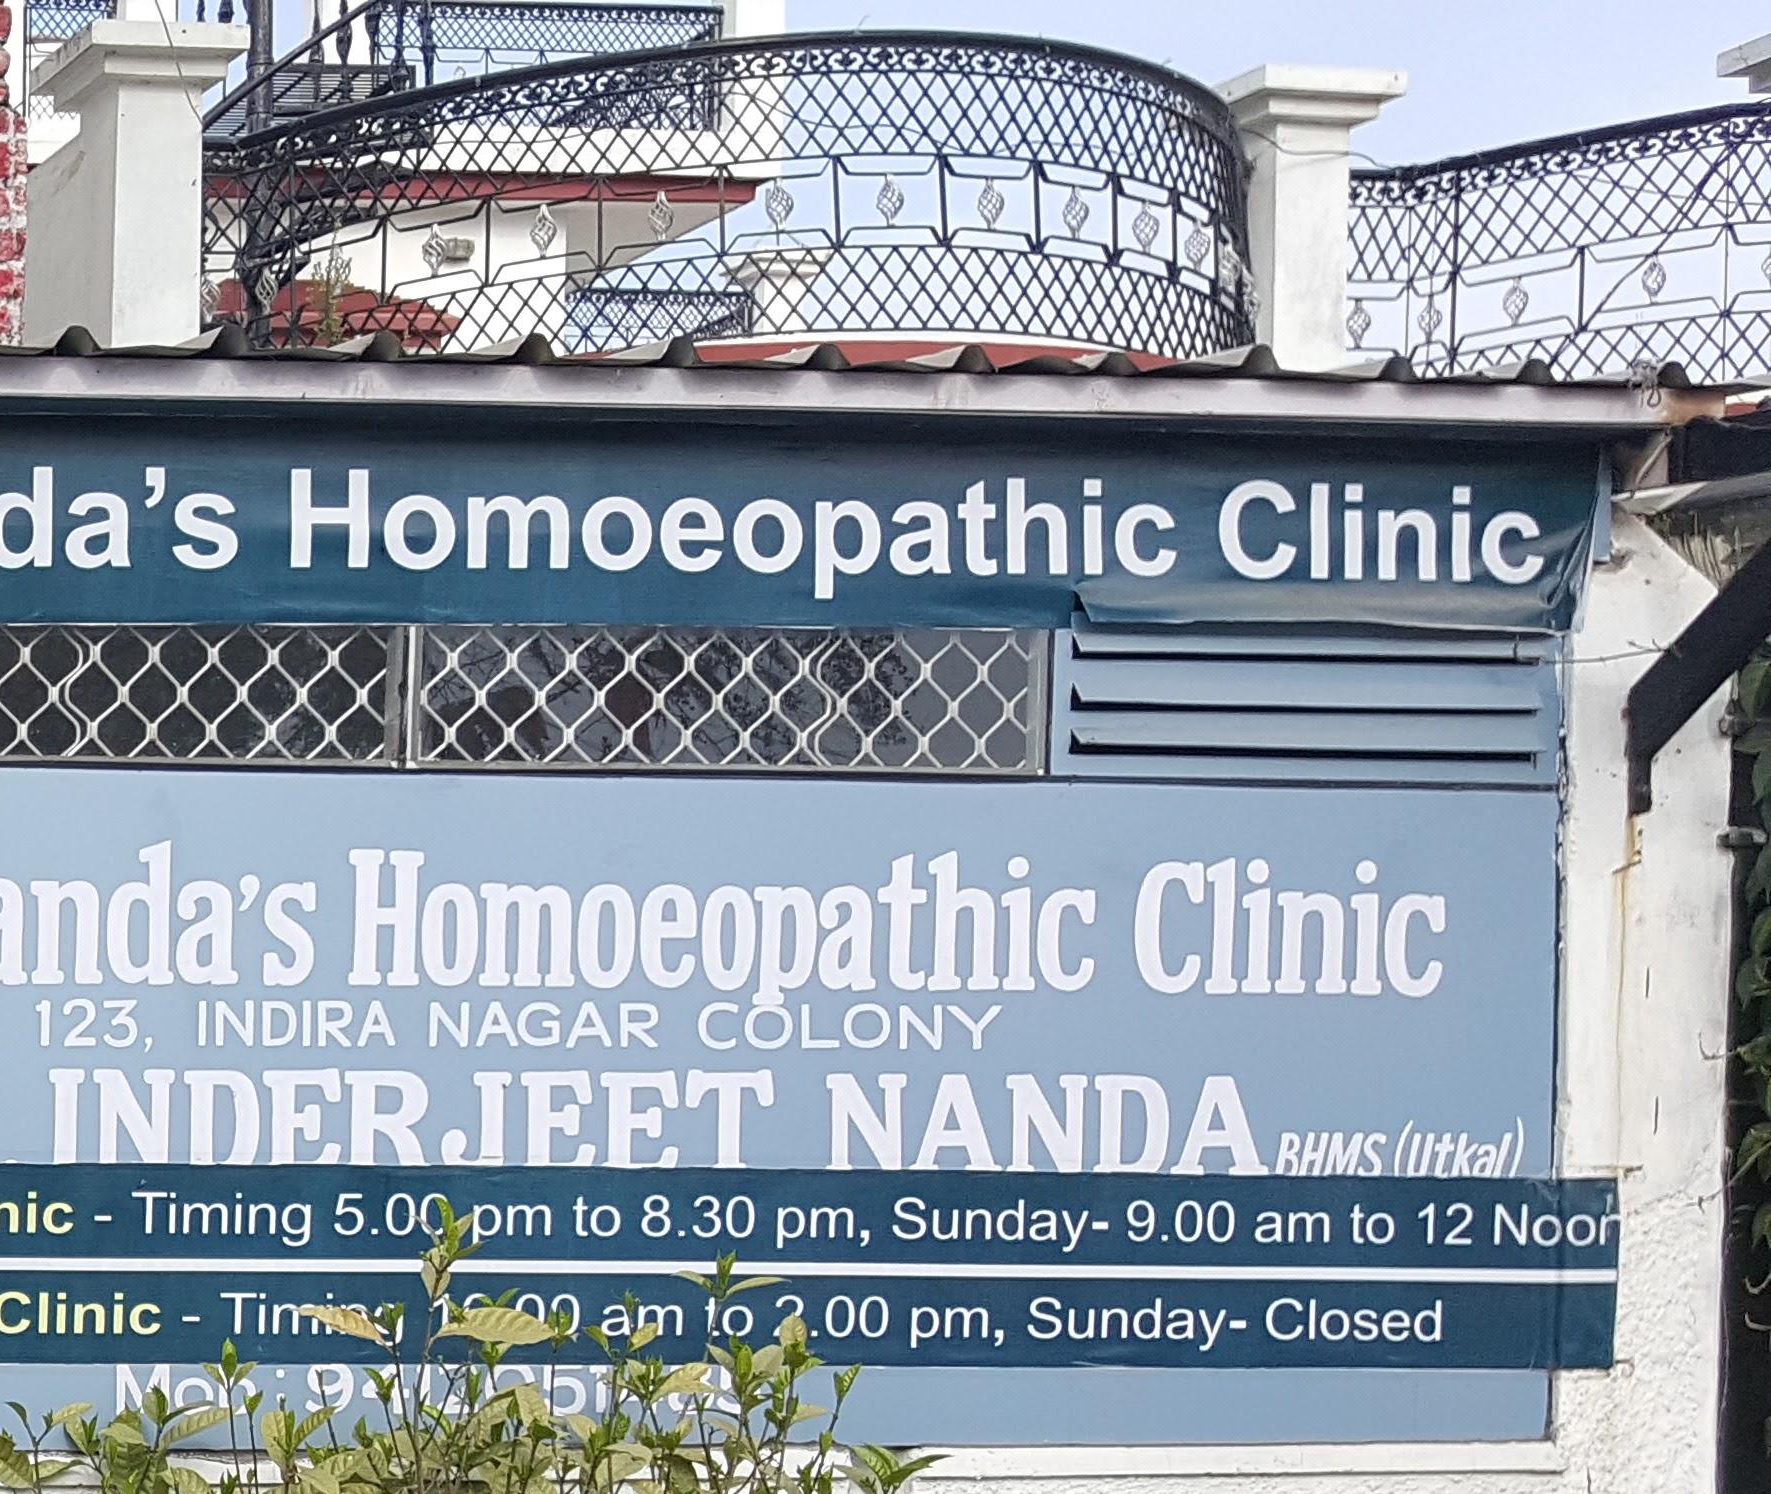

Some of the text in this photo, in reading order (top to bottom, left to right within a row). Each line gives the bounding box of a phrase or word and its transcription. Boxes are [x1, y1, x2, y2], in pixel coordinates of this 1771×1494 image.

[289, 467, 1178, 601] Homoeopathic
[1217, 478, 1546, 585] Clinic
[347, 847, 1097, 1006] Homoeopathic
[1134, 855, 1447, 998] Clinic
[34, 998, 1003, 1054] 123, INDIRA NAGAR COLONY
[47, 1067, 775, 1169] INDERJEET
[824, 1073, 1269, 1174] NANDA
[1274, 1131, 1387, 1176] BHMS
[131, 1191, 312, 1247] Timing
[333, 1192, 452, 1236] 5.00
[472, 1203, 553, 1246] pm
[572, 1195, 622, 1238] to
[640, 1194, 757, 1240] 8.30
[775, 1205, 871, 1250] pm,
[1125, 1199, 1236, 1245] 9.00
[1254, 1210, 1331, 1244] am
[1349, 1203, 1396, 1244] to
[1416, 1202, 1474, 1246] 12
[600, 1303, 684, 1338] am
[704, 1296, 755, 1338] to
[772, 1294, 890, 1339] 2.00
[909, 1305, 1005, 1351] pm,
[1264, 1298, 1444, 1343] Closed
